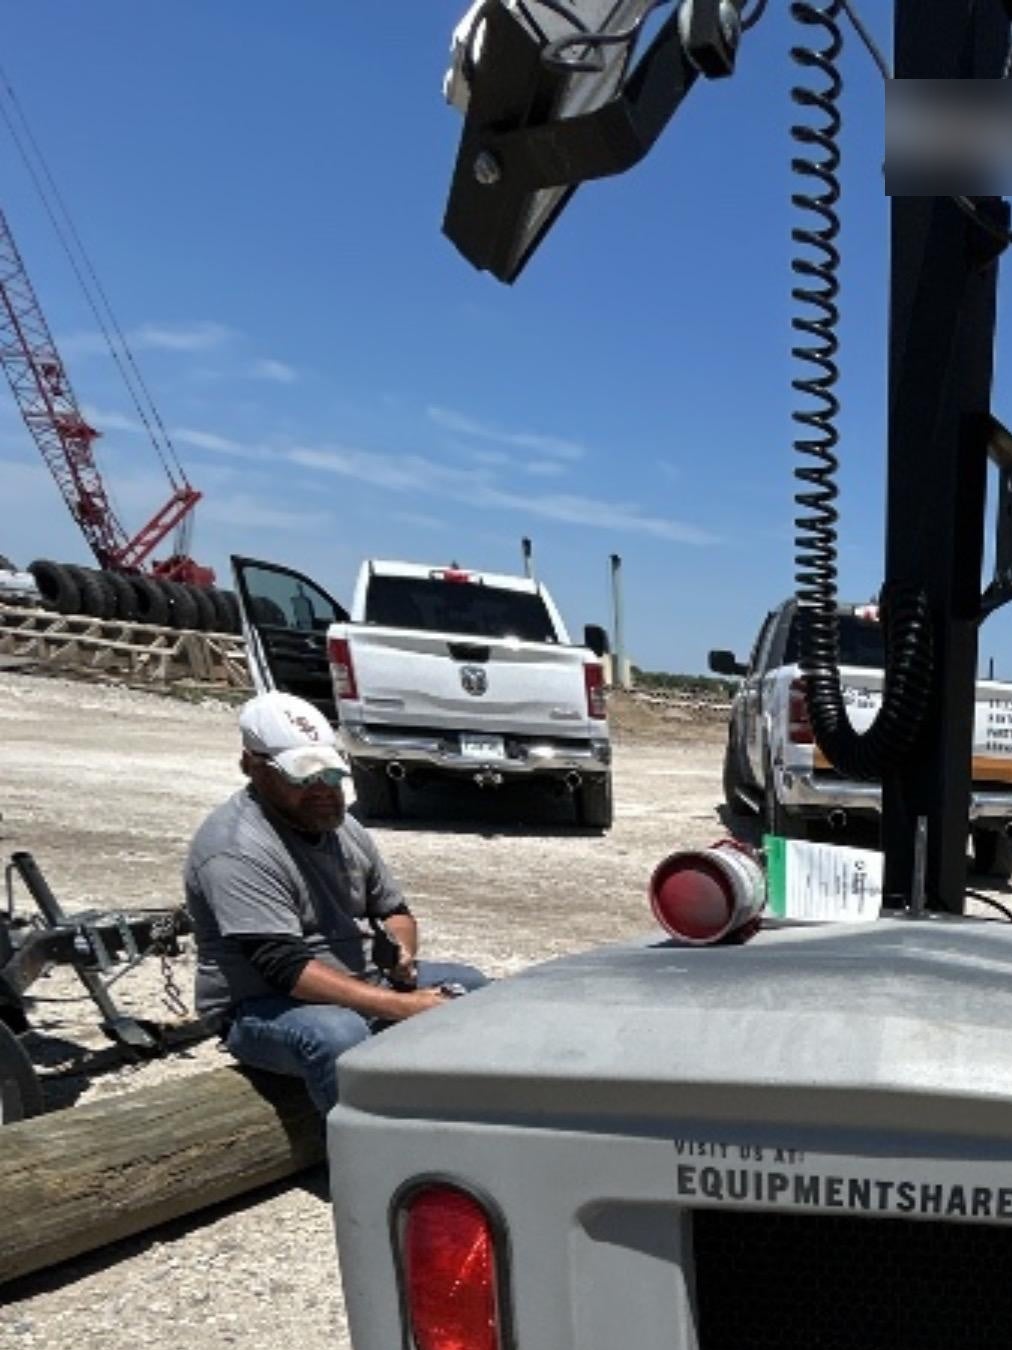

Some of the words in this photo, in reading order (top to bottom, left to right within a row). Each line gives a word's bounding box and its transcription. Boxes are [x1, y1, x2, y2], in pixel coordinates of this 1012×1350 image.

[674, 1138, 728, 1159] VISIT
[740, 1144, 764, 1162] US
[774, 1147, 805, 1165] AT:
